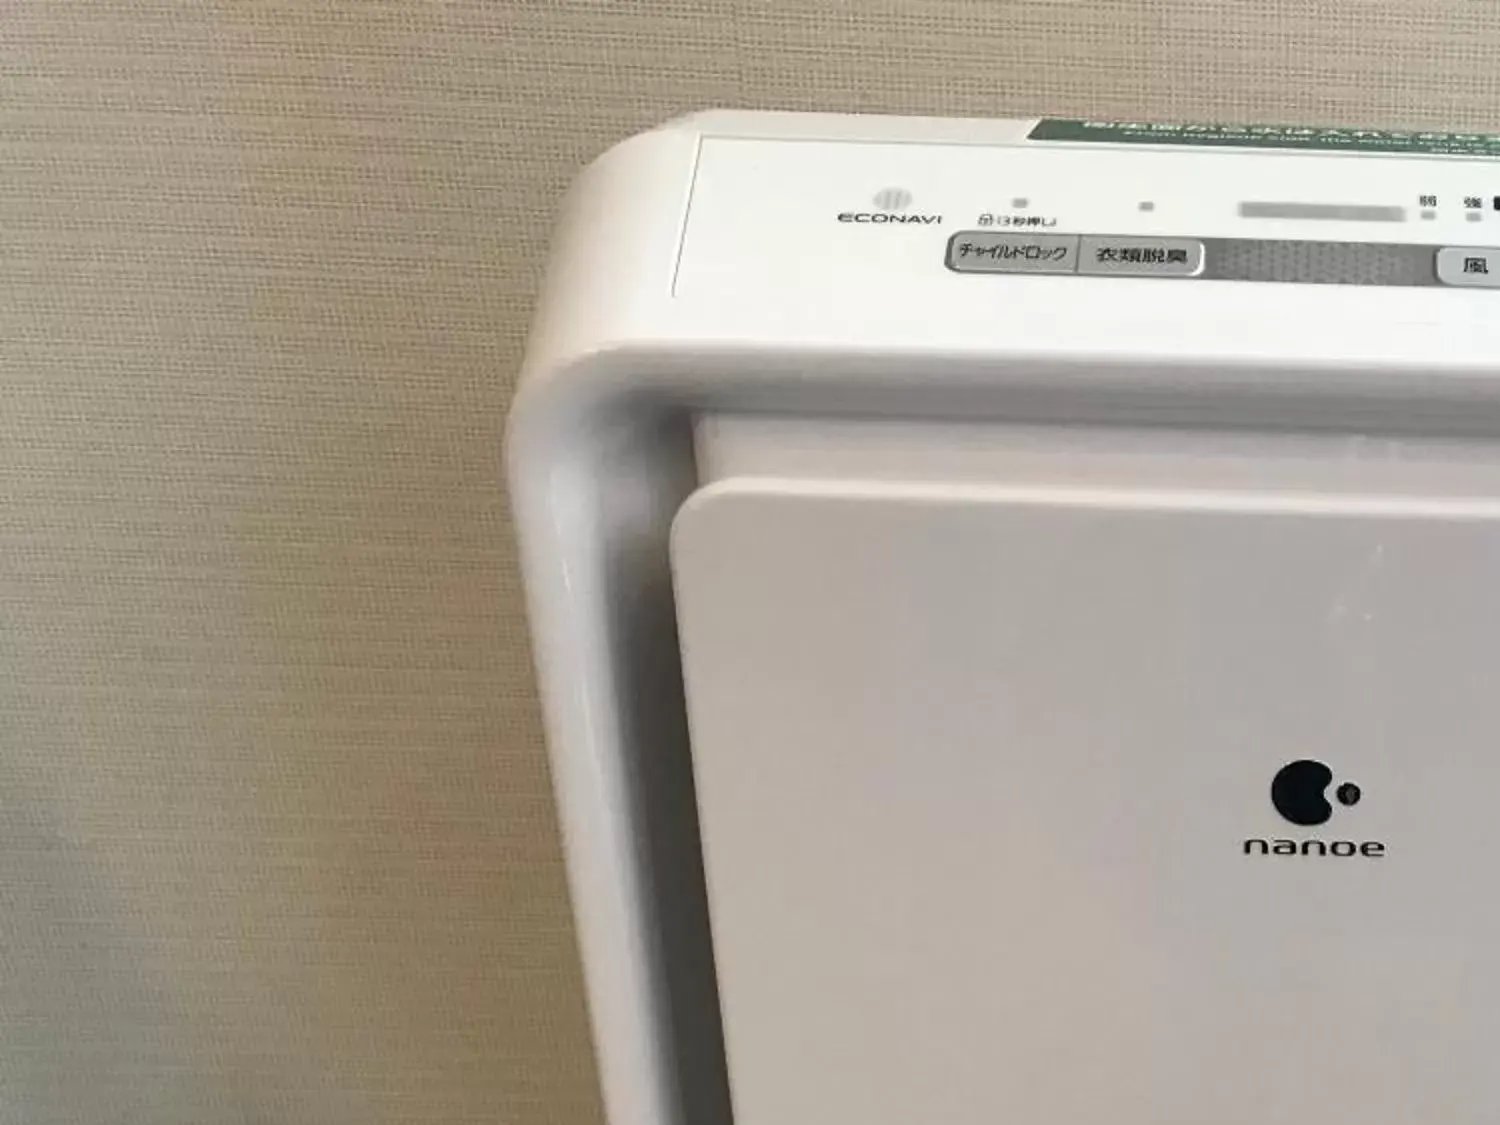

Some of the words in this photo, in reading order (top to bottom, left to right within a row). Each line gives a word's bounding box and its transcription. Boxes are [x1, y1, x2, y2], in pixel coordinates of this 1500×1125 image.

[837, 213, 942, 224] ECONAVI
[959, 243, 1068, 260] チャイルドロック
[1097, 247, 1187, 264] 衣類脱臭
[1243, 838, 1386, 857] nanoe
